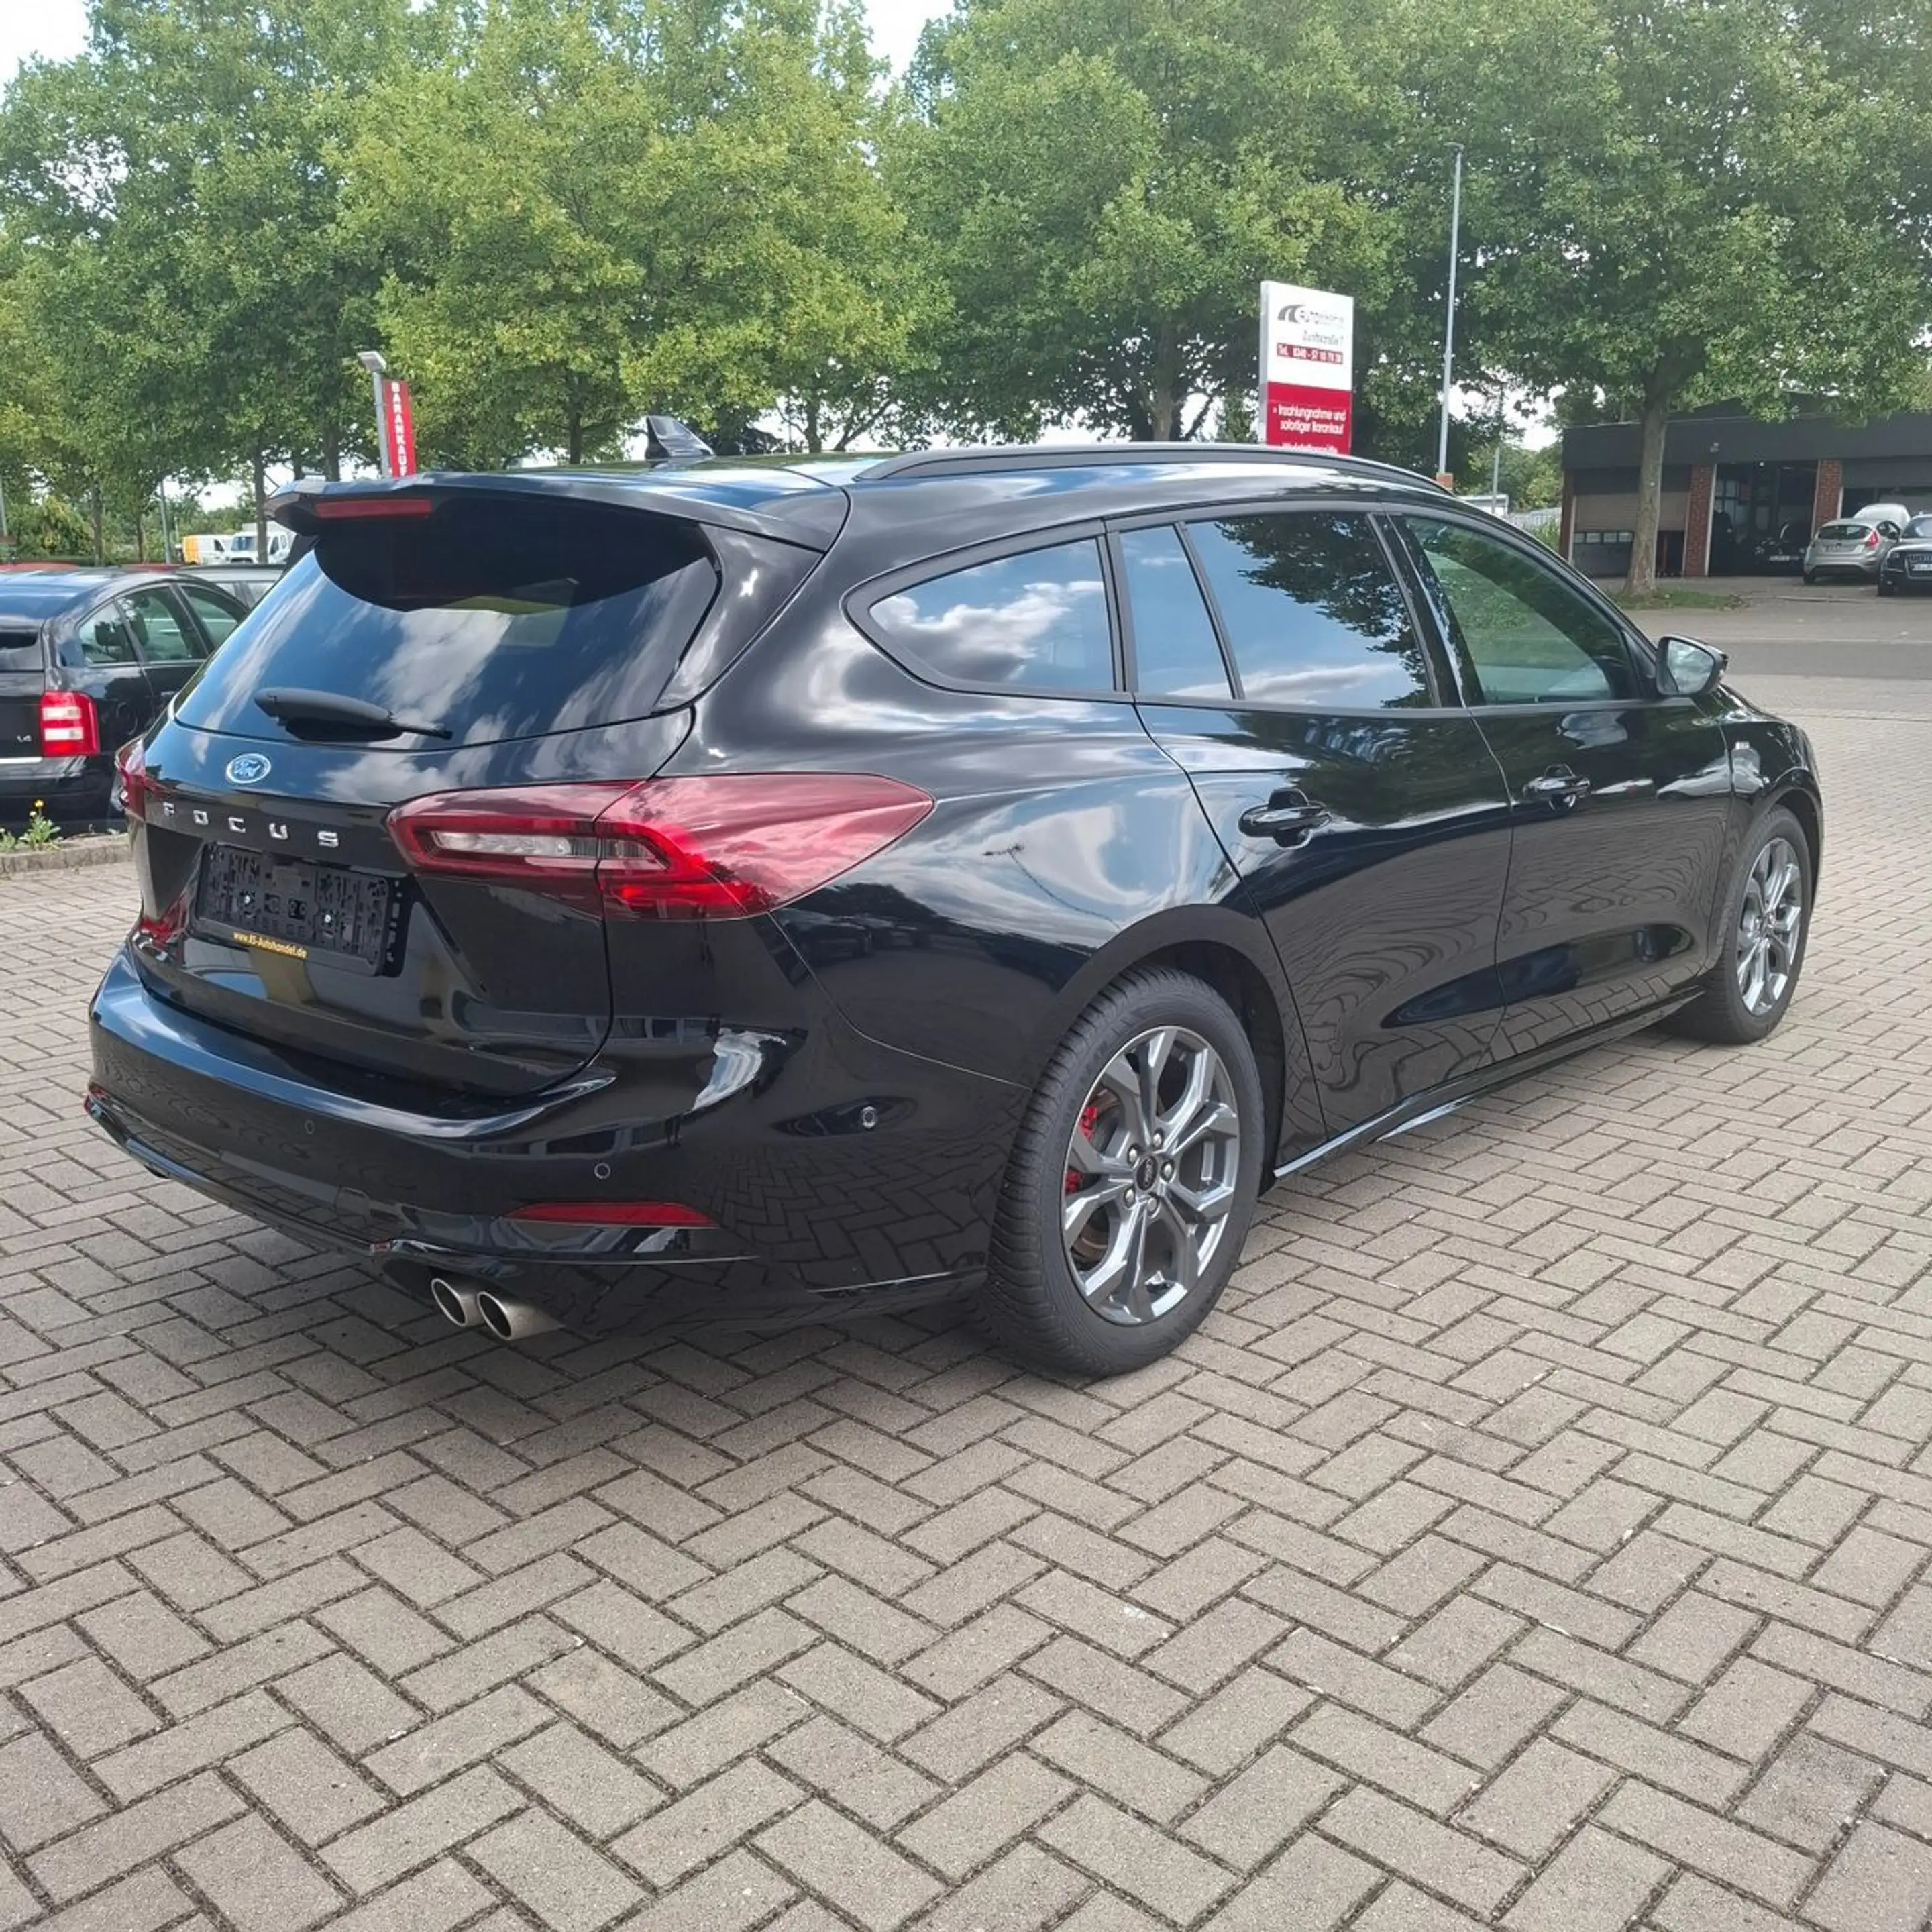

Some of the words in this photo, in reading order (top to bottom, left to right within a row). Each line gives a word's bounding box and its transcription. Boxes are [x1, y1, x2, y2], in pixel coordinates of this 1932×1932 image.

[1278, 404, 1332, 421] Inzahlungnahme
[1333, 410, 1346, 421] und
[163, 802, 339, 848] FOCUS
